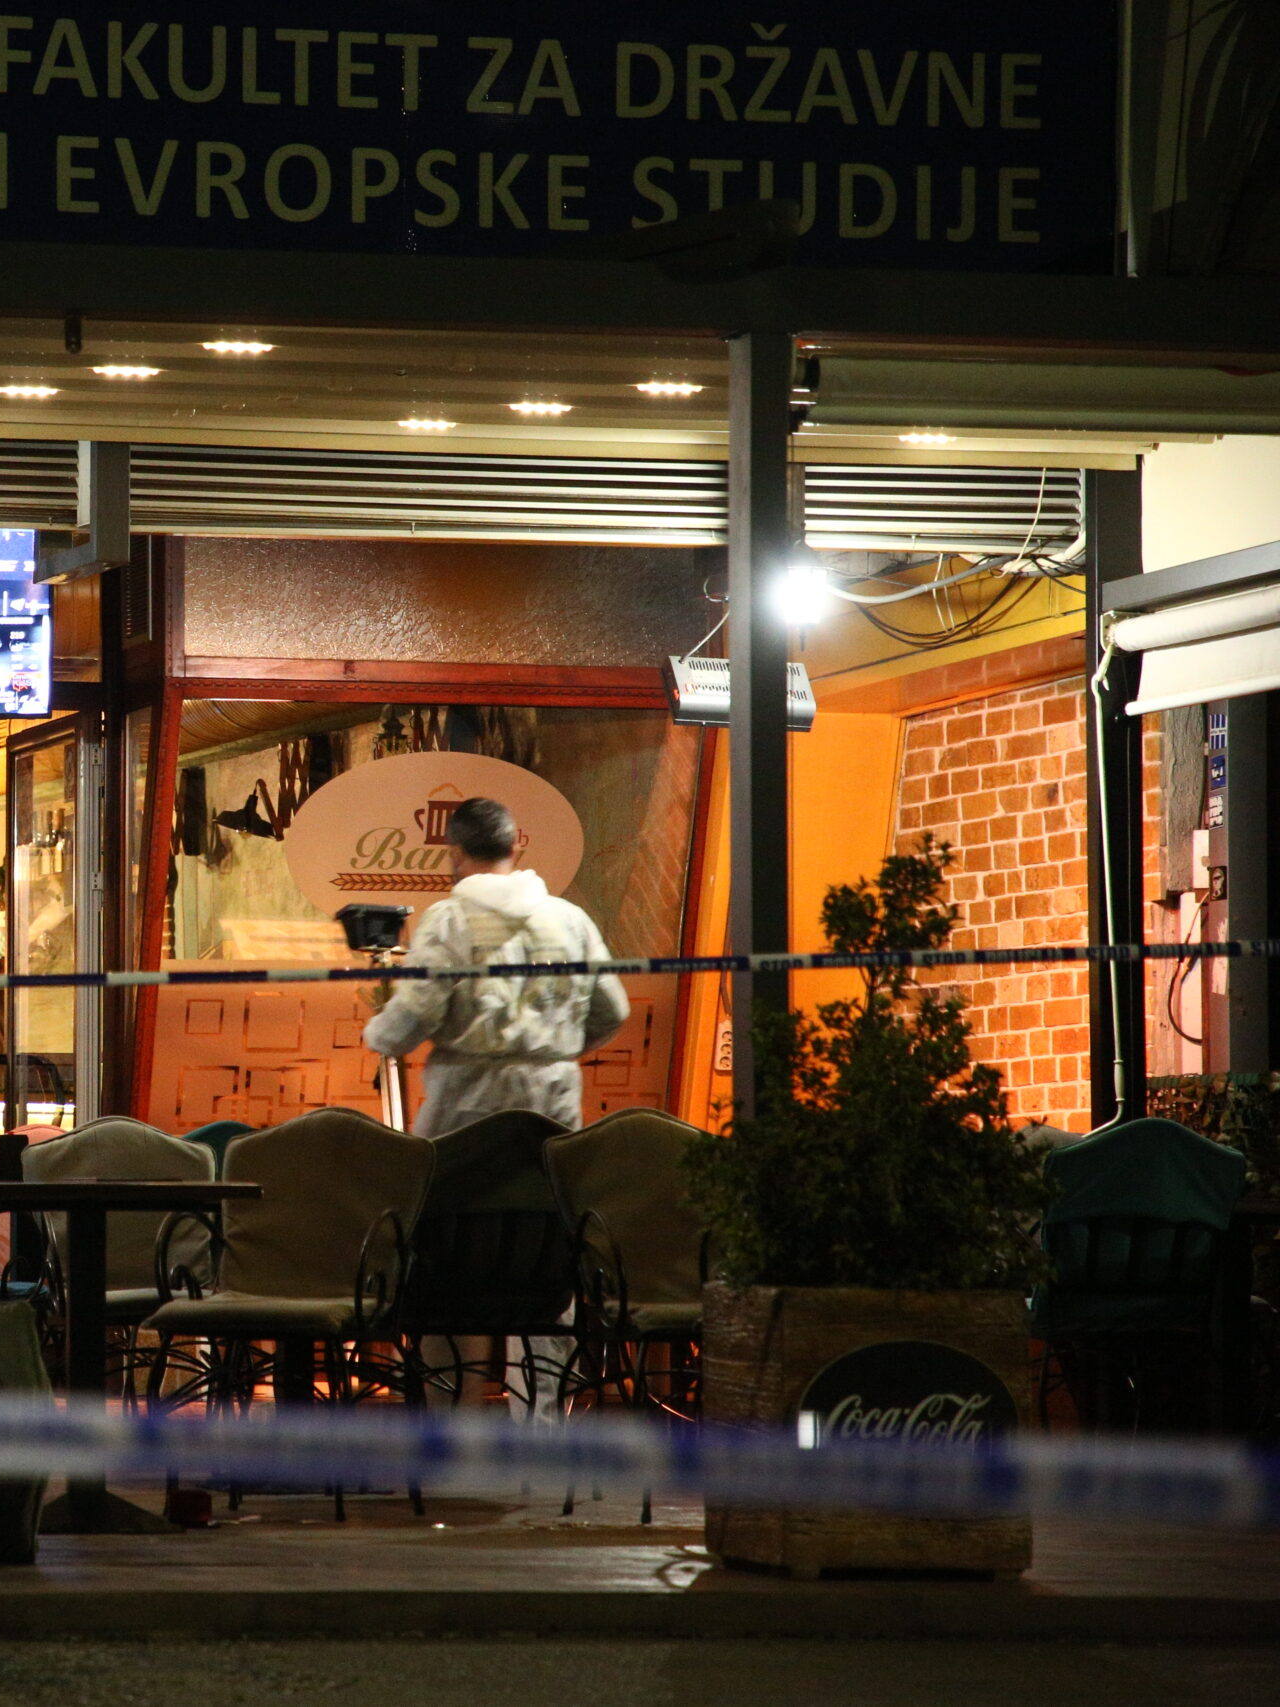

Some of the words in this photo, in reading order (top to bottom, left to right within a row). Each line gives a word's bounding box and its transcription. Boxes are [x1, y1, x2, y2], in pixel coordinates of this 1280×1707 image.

[466, 36, 582, 116] ZA
[616, 23, 1042, 130] DRŽAVNE
[56, 134, 590, 230] EVROPSKE
[631, 155, 1041, 243] STUDIJE
